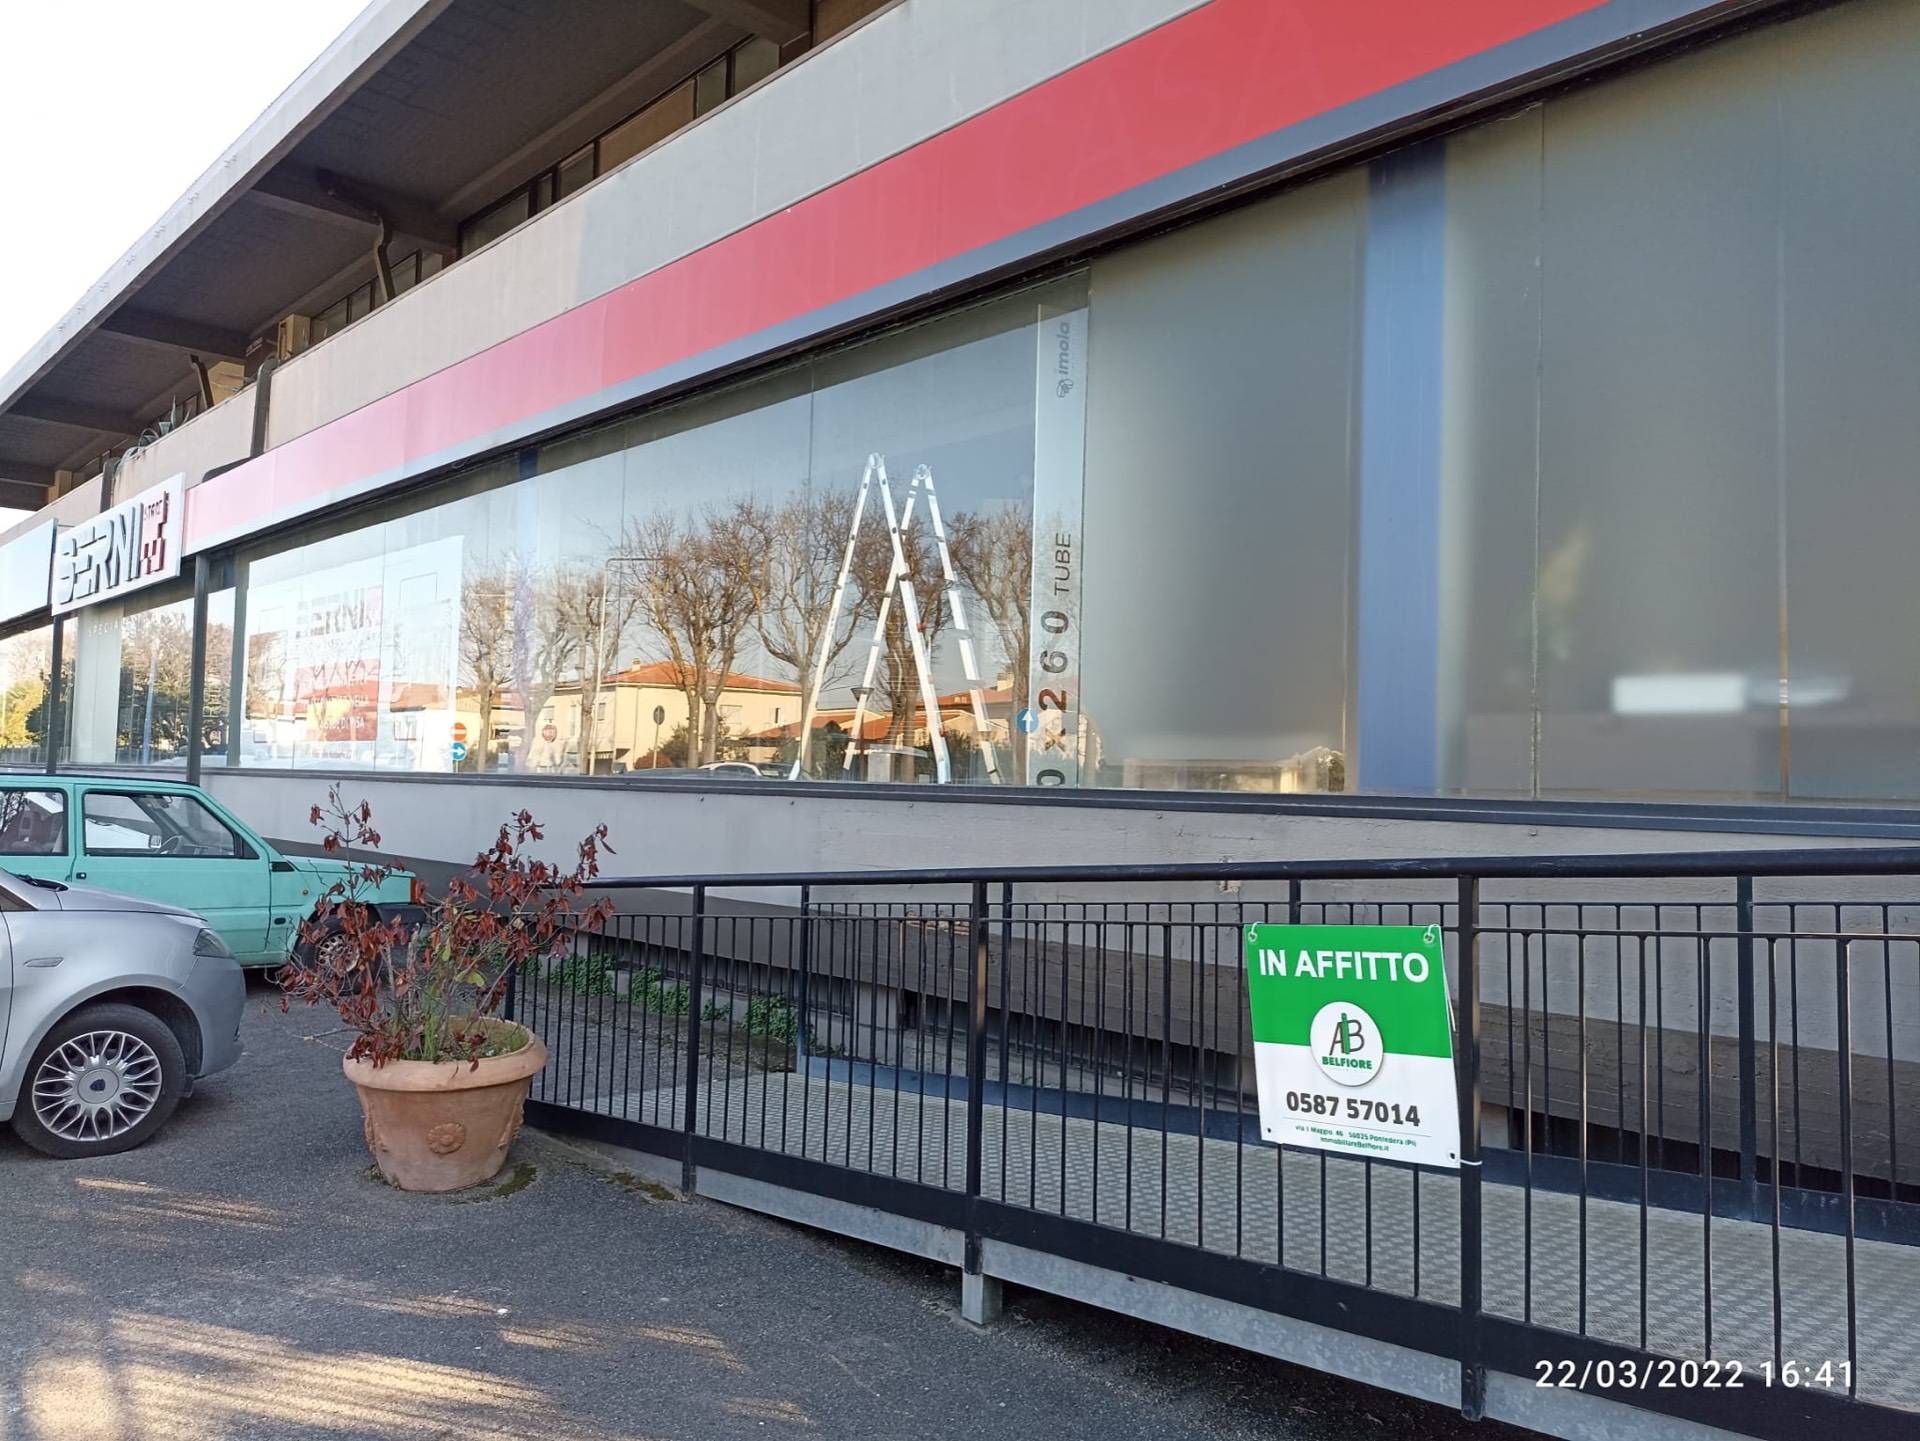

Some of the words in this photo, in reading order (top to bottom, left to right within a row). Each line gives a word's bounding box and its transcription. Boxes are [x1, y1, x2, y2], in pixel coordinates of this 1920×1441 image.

[1057, 322, 1070, 375] imola
[1054, 532, 1071, 596] TUBE
[1258, 948, 1287, 977] IN
[1294, 949, 1430, 983] AFFITTO
[1322, 1056, 1373, 1070] BELFIORE
[1286, 1091, 1339, 1116] 0587
[1346, 1098, 1420, 1127] 57014
